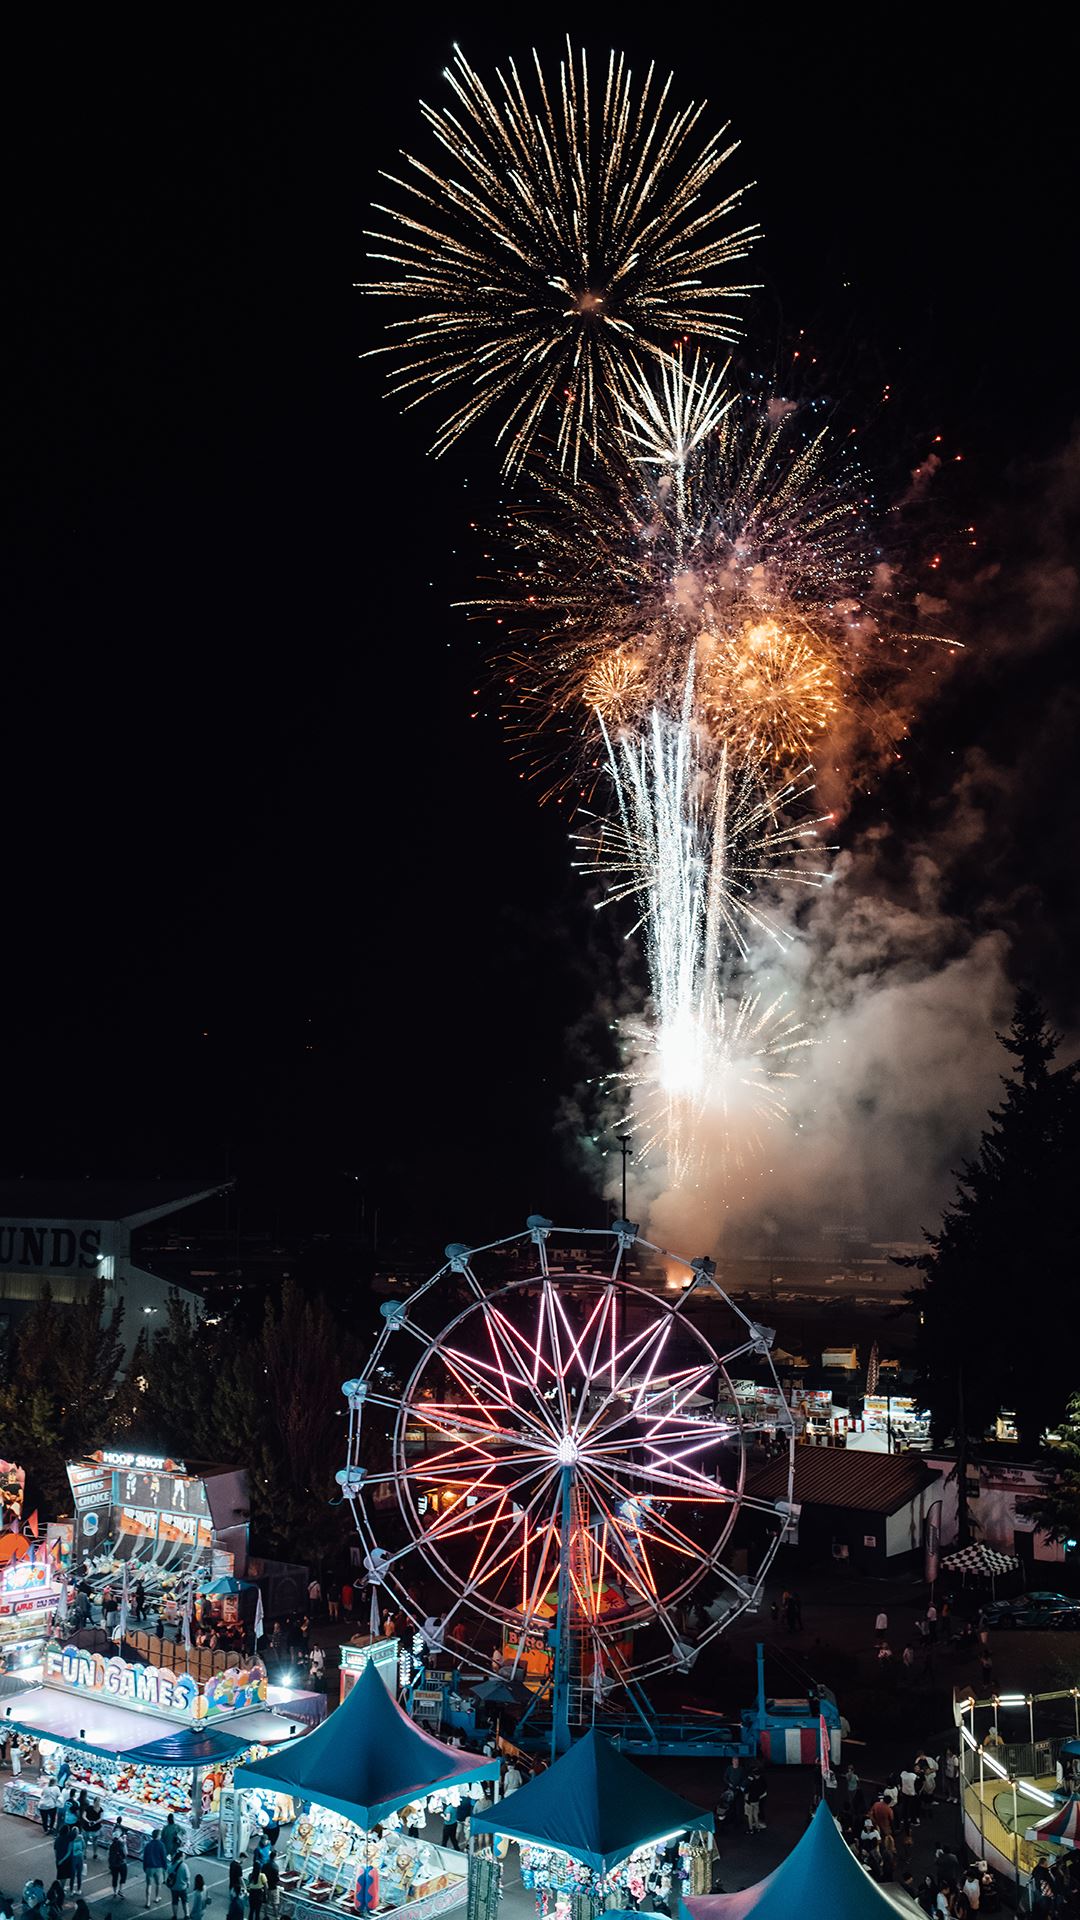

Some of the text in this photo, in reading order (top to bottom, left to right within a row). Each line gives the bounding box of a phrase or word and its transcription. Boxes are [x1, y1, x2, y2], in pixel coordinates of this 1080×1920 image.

[0, 1226, 100, 1269] UNDS
[103, 1452, 165, 1470] HOOP SHOT
[77, 1480, 104, 1493] WINS
[78, 1491, 110, 1507] CHOICE
[47, 1652, 191, 1710] FUN GAMES
